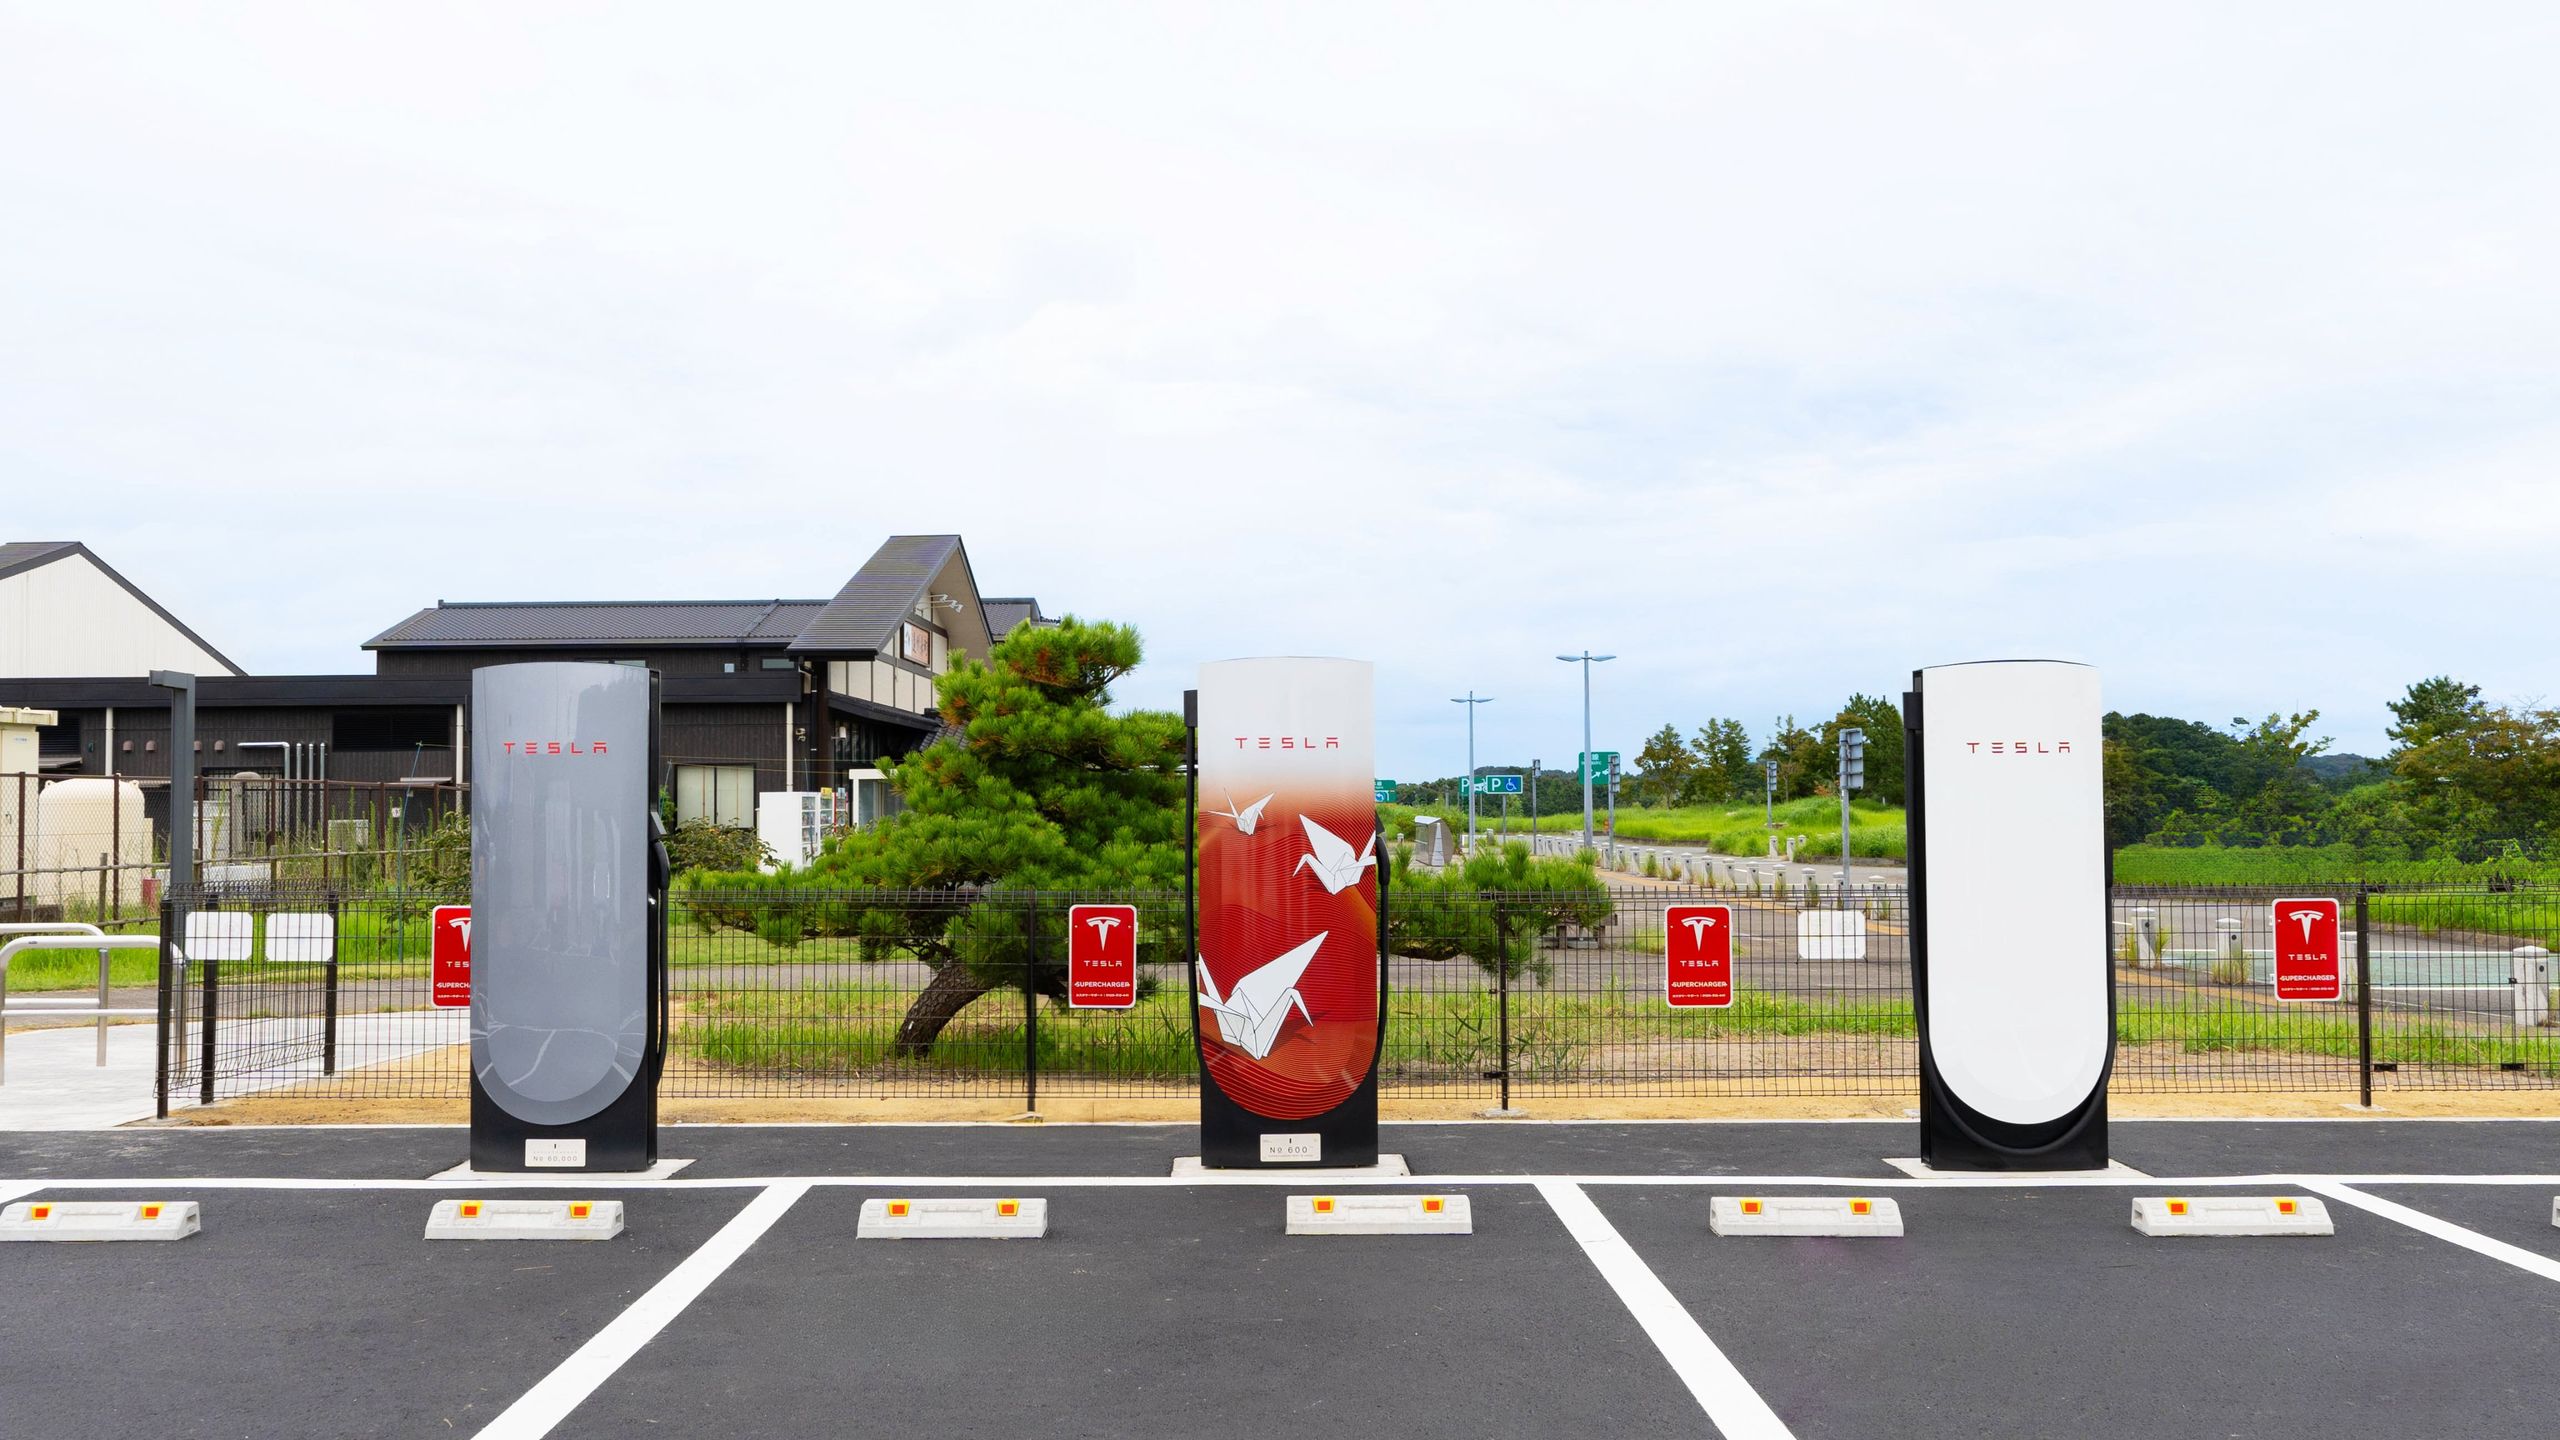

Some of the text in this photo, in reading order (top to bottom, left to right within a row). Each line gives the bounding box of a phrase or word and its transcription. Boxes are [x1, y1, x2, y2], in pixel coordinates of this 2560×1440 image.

[504, 741, 608, 755] TESLA
[1235, 737, 1339, 749] TESLA
[1966, 741, 2070, 754] TESLA
[1491, 778, 1501, 791] P
[2287, 953, 2328, 961] TESLA
[446, 960, 470, 968] TES
[436, 981, 470, 989] SUPERCH
[1287, 1146, 1308, 1154] 600
